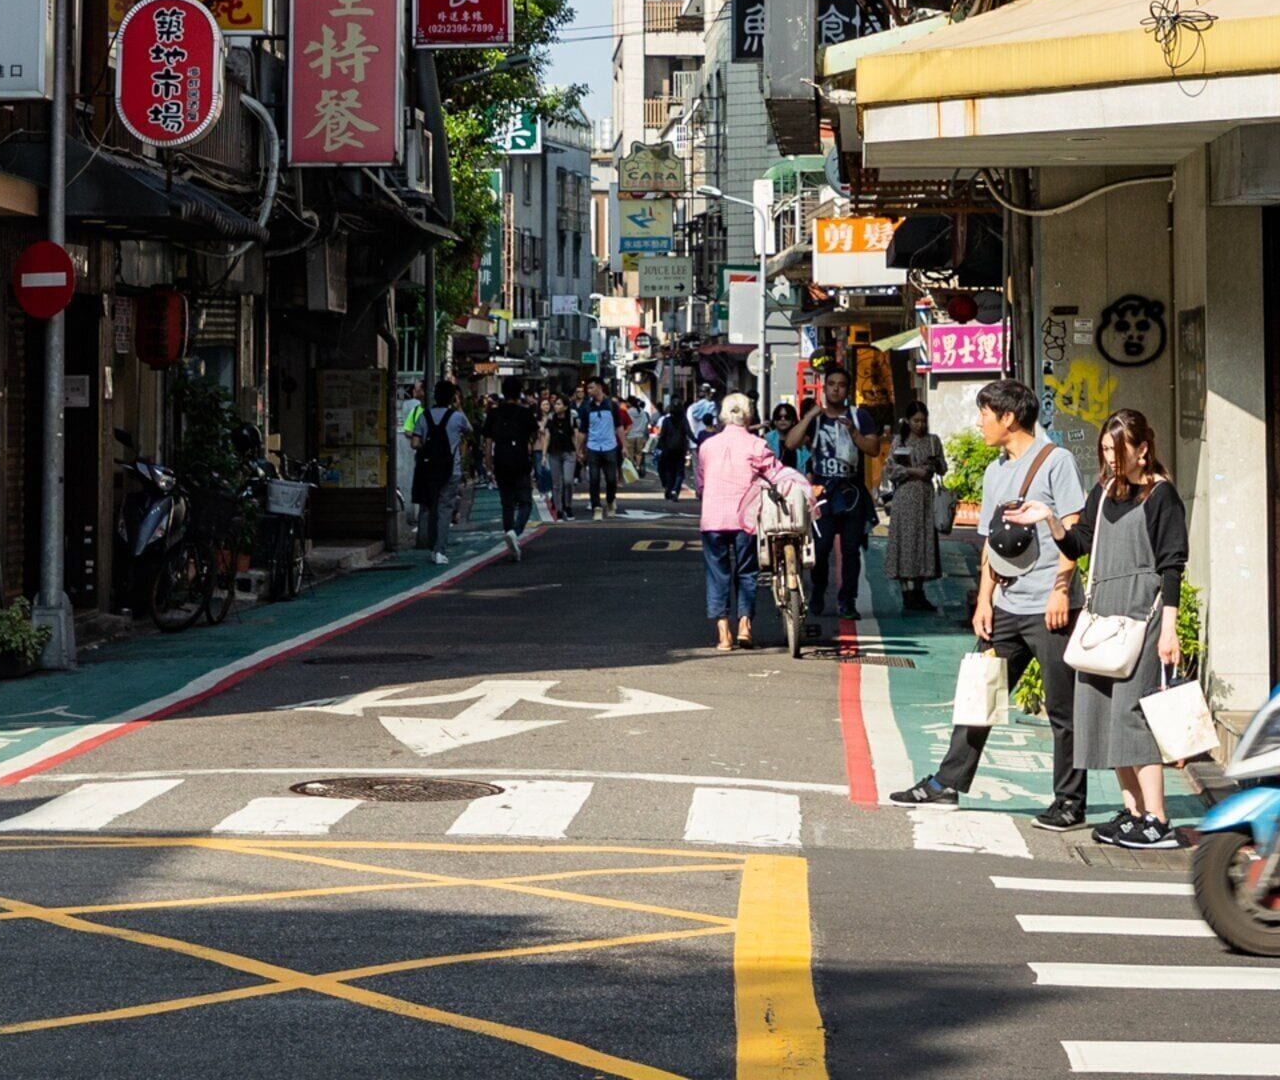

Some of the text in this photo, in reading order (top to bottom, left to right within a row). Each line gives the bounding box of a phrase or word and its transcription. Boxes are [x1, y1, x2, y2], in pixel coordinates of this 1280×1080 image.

[428, 23, 494, 34] (02)2396-7899
[147, 8, 187, 134] 築地市場
[627, 171, 678, 181] CARA
[644, 265, 687, 276] JOYCE LEE
